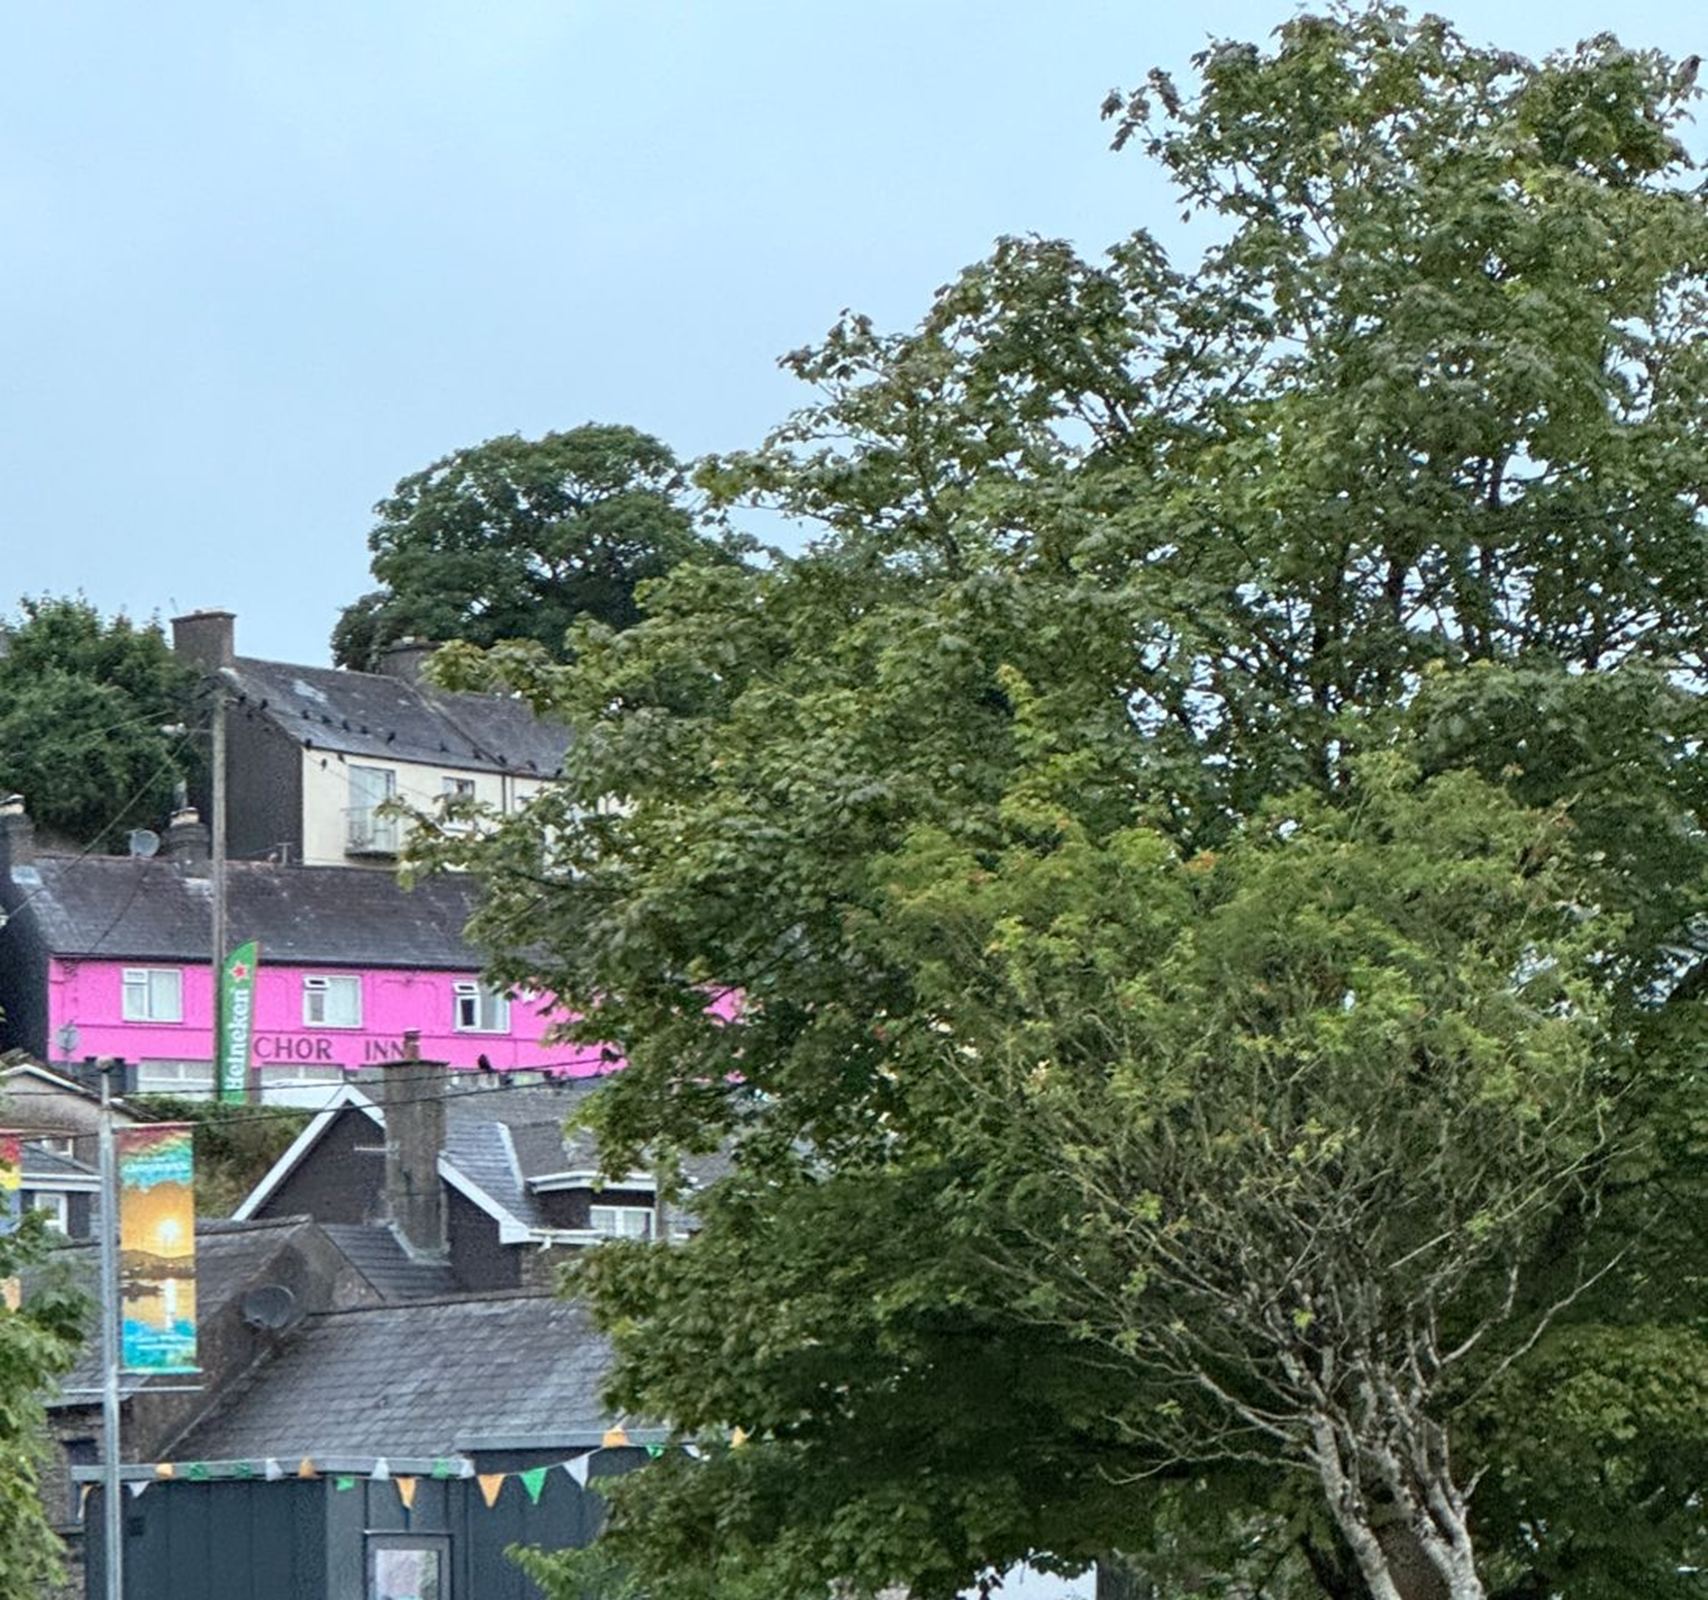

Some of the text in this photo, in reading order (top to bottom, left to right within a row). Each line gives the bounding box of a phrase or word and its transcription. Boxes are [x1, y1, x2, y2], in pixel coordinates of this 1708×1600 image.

[224, 988, 249, 1090] Heineken
[253, 1036, 406, 1061] CHOR INN
